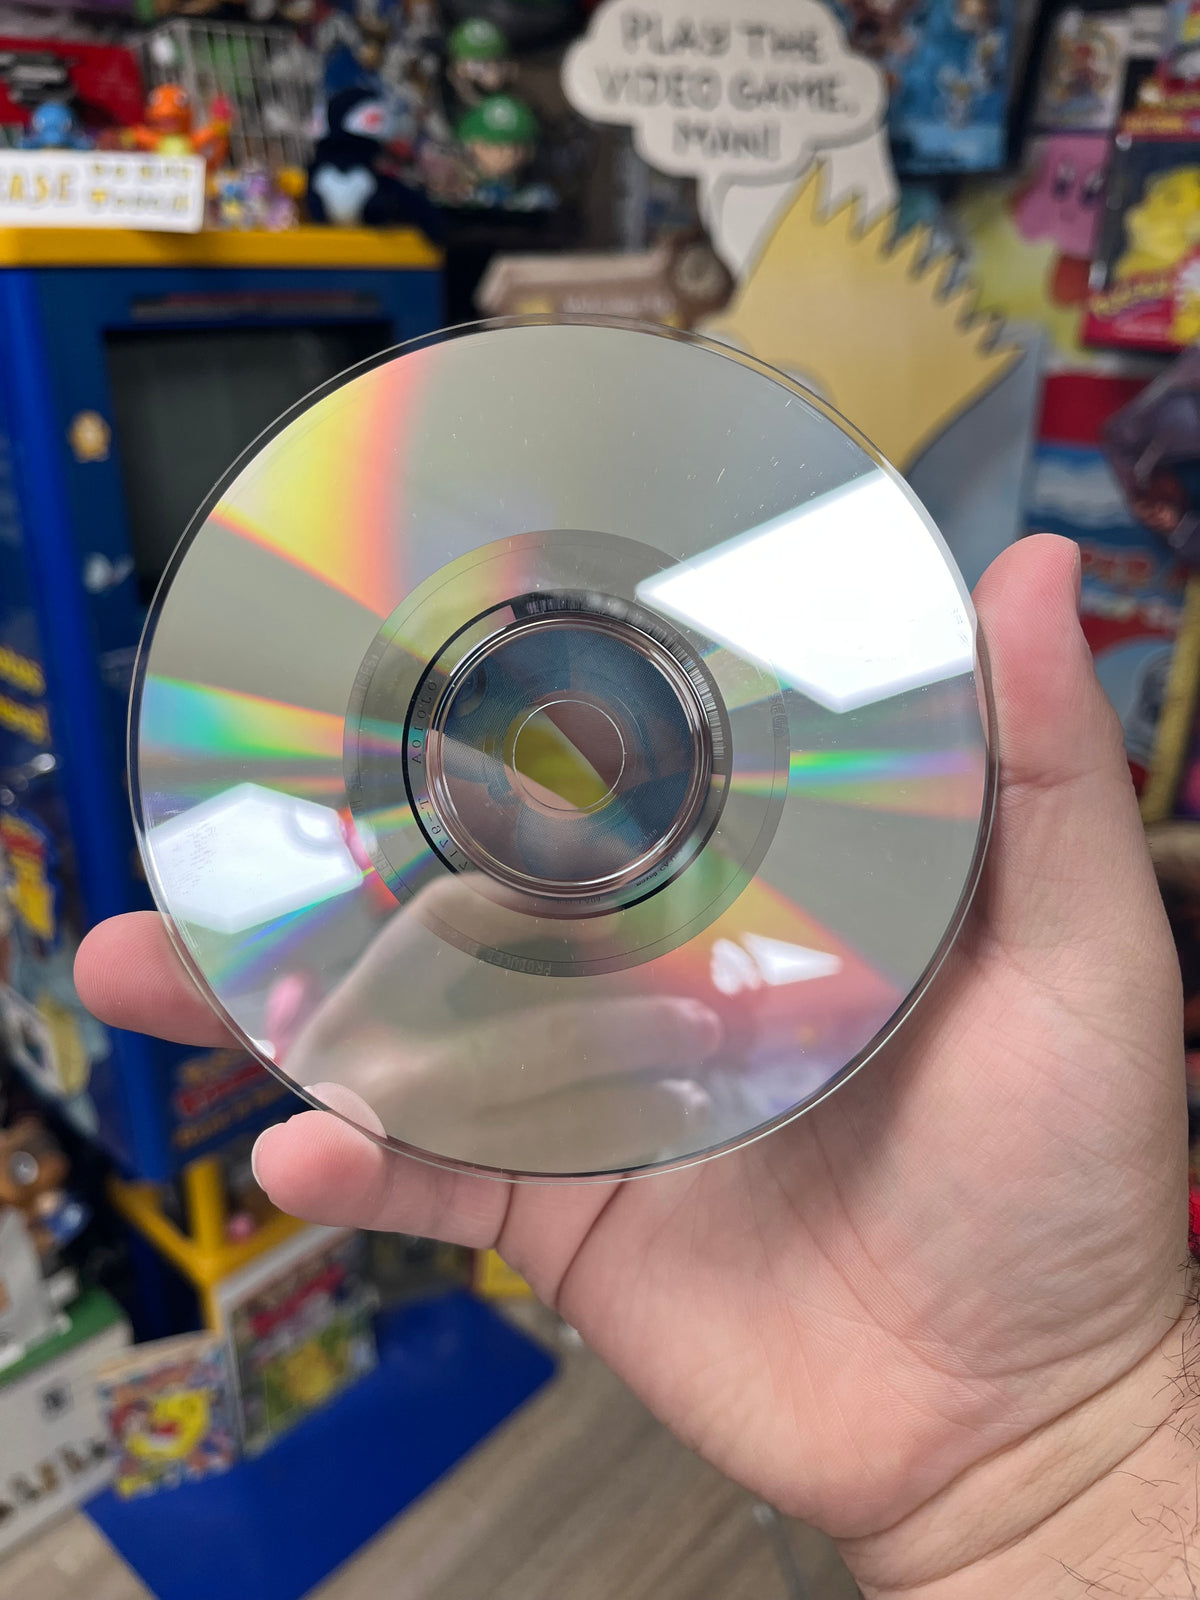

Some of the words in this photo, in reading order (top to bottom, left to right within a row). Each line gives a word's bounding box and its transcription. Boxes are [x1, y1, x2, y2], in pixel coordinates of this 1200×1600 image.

[621, 8, 730, 56] PLAY
[737, 19, 822, 63] THE
[595, 65, 722, 111] VIDEO
[0, 168, 76, 205] ASE
